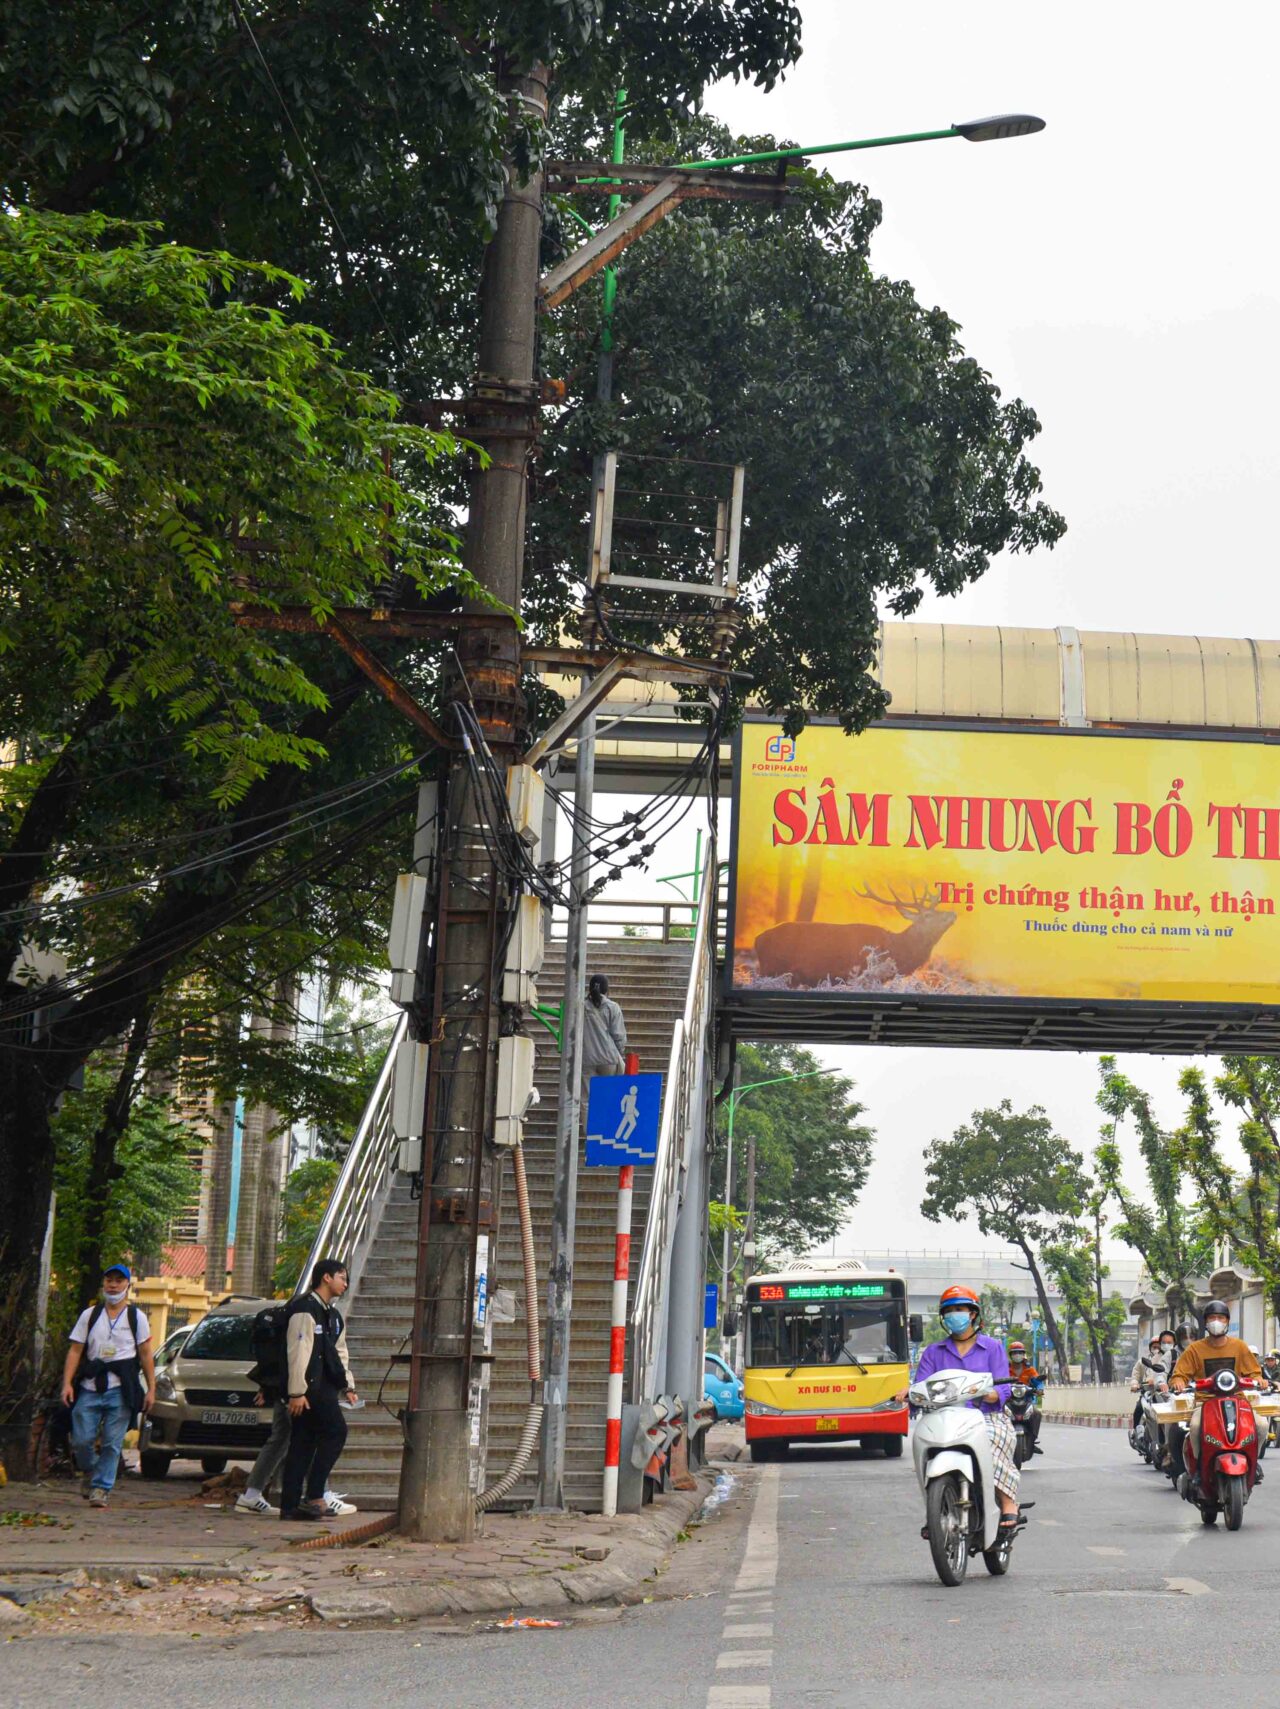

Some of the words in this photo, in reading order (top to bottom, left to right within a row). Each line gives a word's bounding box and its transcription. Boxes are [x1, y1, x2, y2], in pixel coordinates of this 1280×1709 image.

[751, 763, 808, 772] FORIPHARM
[772, 777, 893, 848] SÂM
[904, 794, 1099, 855] NHUNG
[1112, 778, 1193, 858] BỔ
[935, 881, 975, 912] Trị
[983, 883, 1070, 913] chứng
[1079, 886, 1144, 918] thận
[1154, 889, 1201, 917] hư,
[1210, 890, 1276, 922] thận
[1023, 917, 1067, 932] Thuốc
[1072, 921, 1108, 936] dùng
[1111, 923, 1137, 934] cho
[1141, 922, 1156, 935] cả
[1161, 926, 1191, 936] nam
[1196, 924, 1210, 937] và
[1215, 927, 1234, 937] nữ
[760, 1286, 784, 1299] 53A
[813, 1385, 830, 1393] BUS
